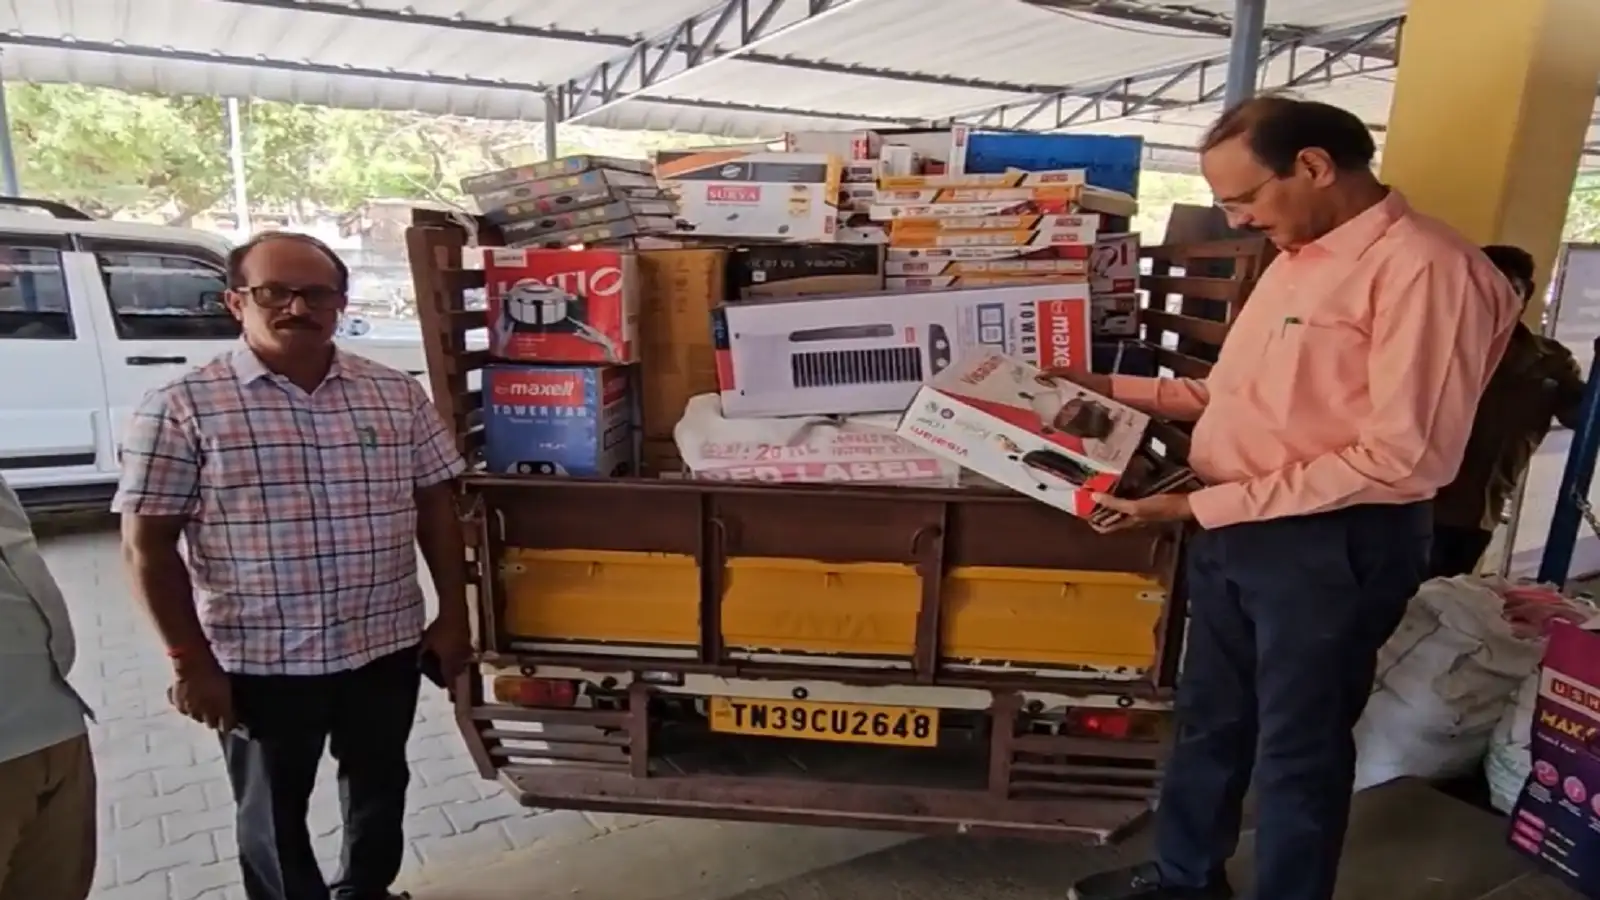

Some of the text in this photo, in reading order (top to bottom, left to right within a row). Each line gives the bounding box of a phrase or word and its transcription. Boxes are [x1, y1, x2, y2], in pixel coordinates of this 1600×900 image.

[1019, 301, 1036, 354] TOWER
[1050, 316, 1071, 368] maxe
[510, 380, 574, 396] maxell
[492, 404, 588, 418] TOWER FAN
[797, 460, 936, 483] LABEL
[731, 703, 930, 739] TN39CU2648
